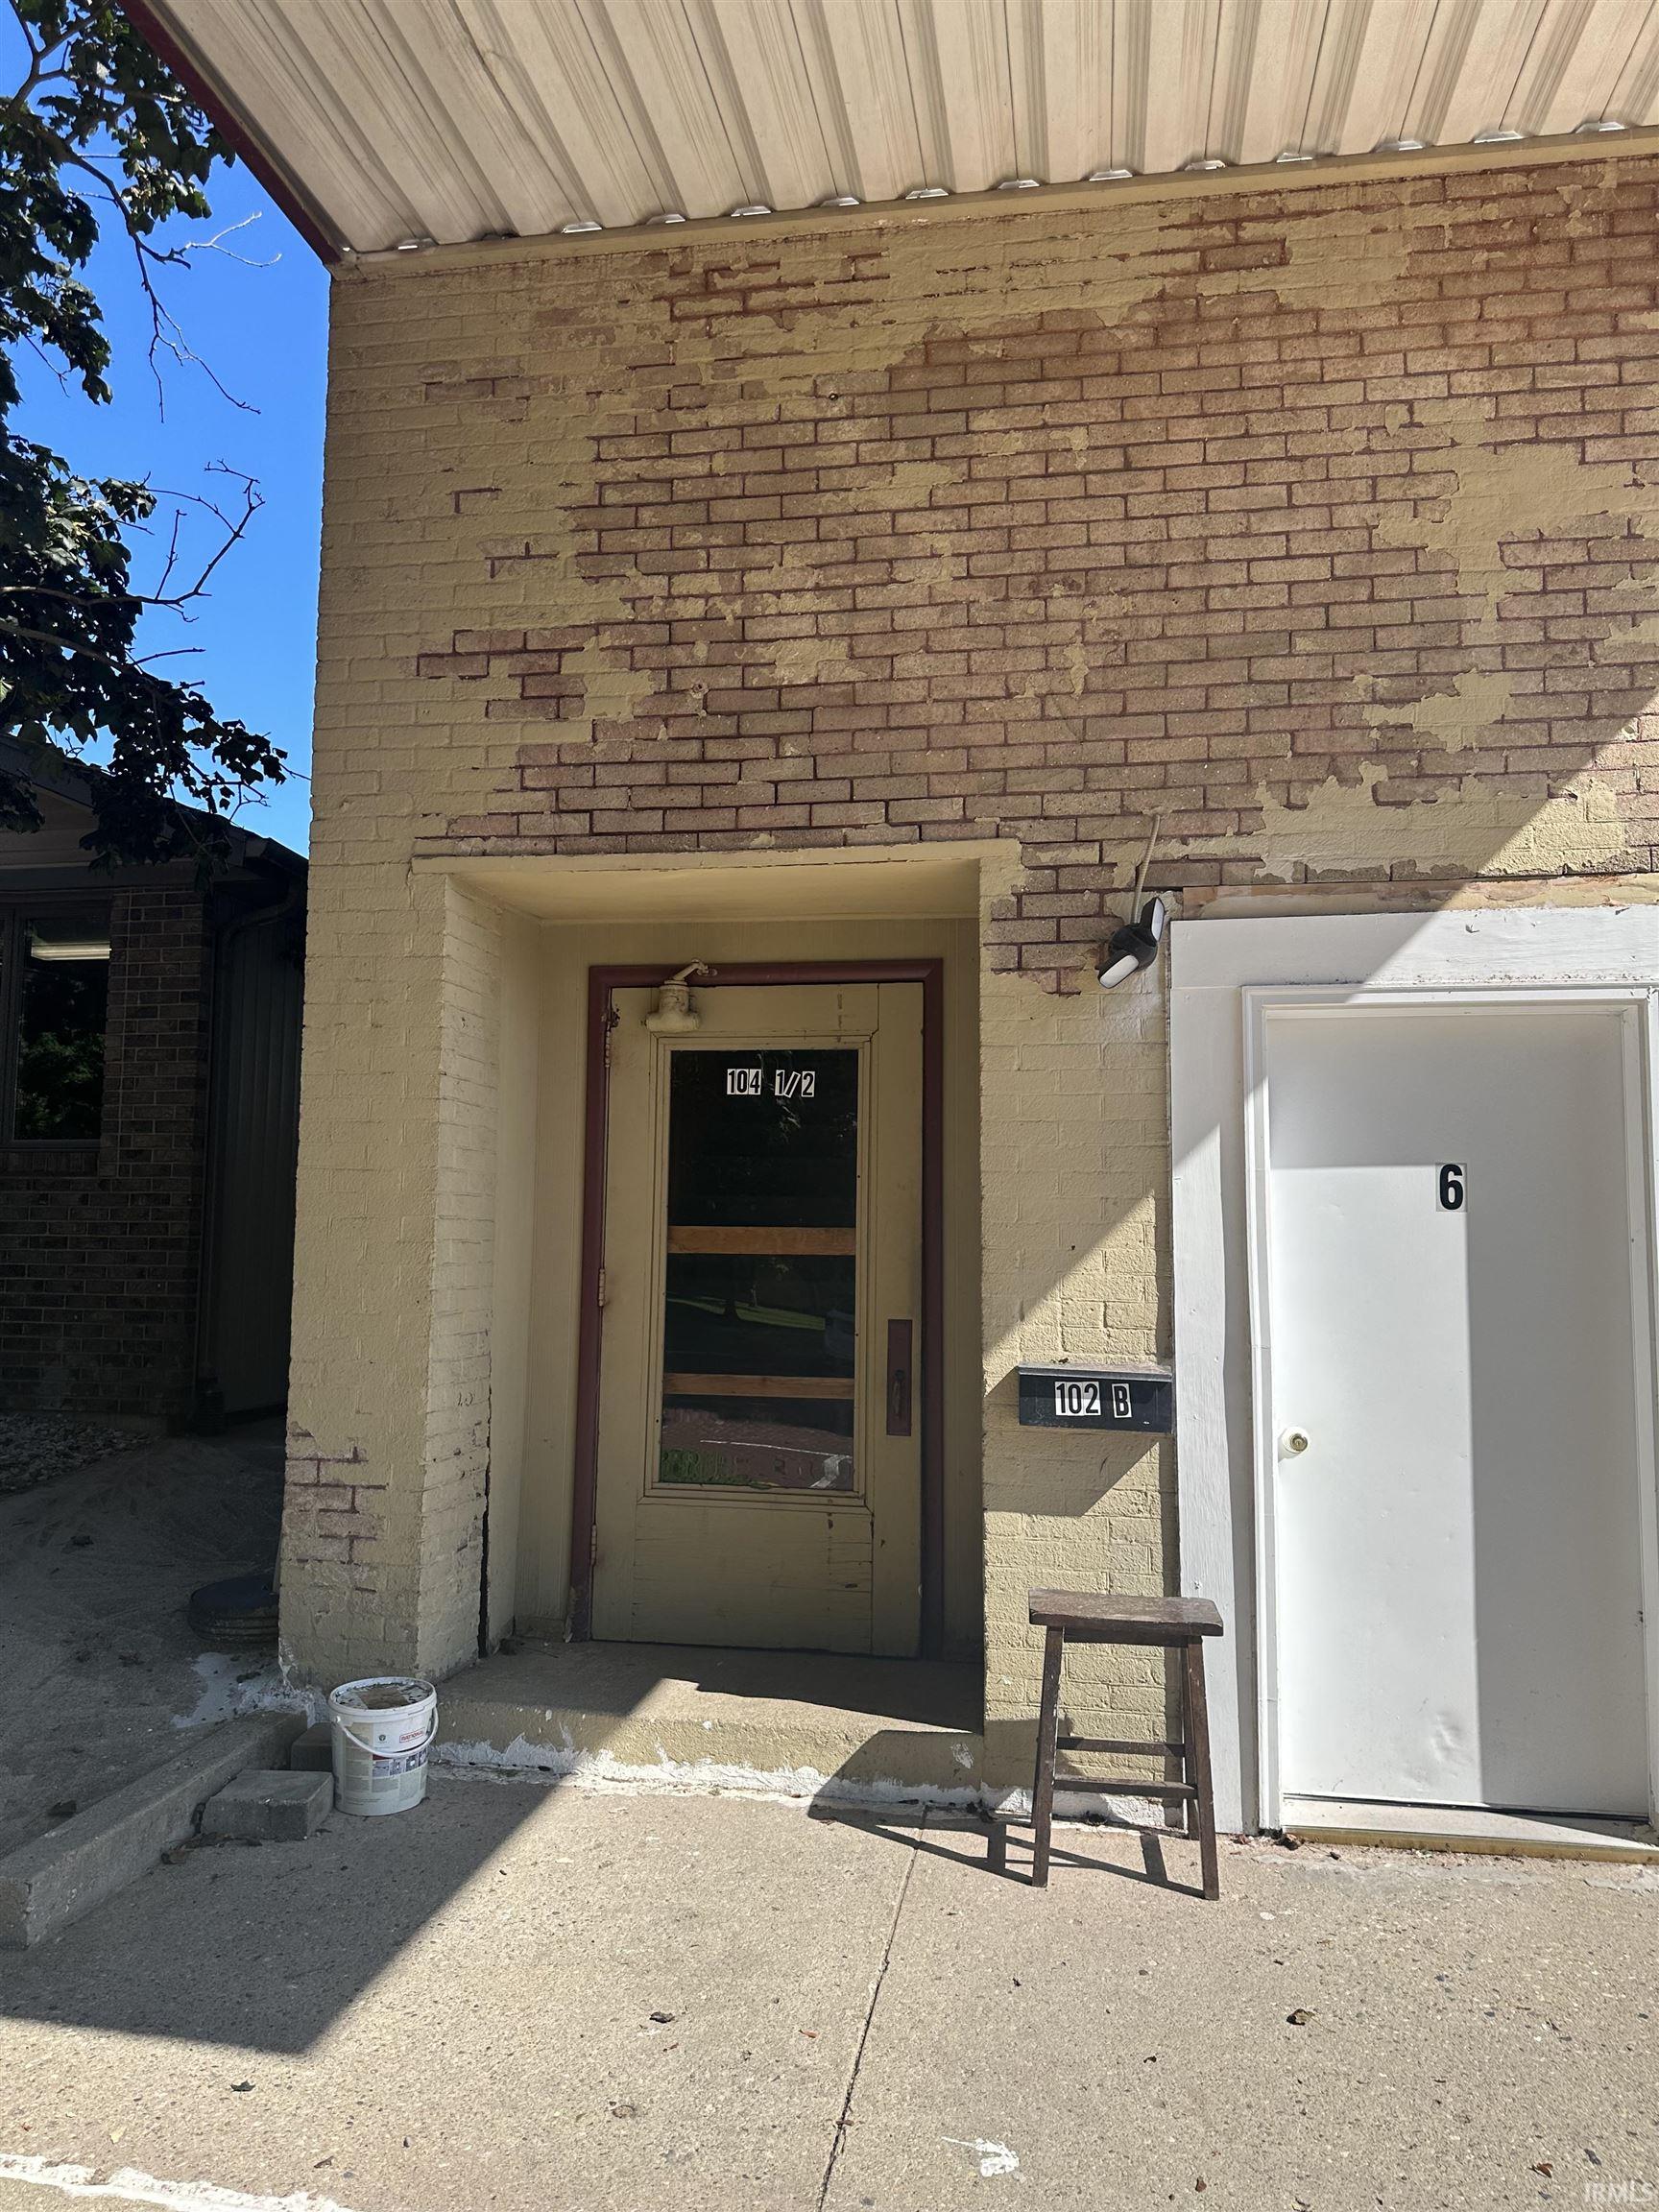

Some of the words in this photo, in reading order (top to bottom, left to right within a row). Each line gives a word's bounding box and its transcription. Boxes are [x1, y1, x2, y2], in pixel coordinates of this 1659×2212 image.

[728, 1070, 760, 1094] 104
[776, 1070, 814, 1096] 1/2
[1438, 1164, 1464, 1211] 6
[1056, 1382, 1099, 1415] 102
[1113, 1384, 1130, 1417] B
